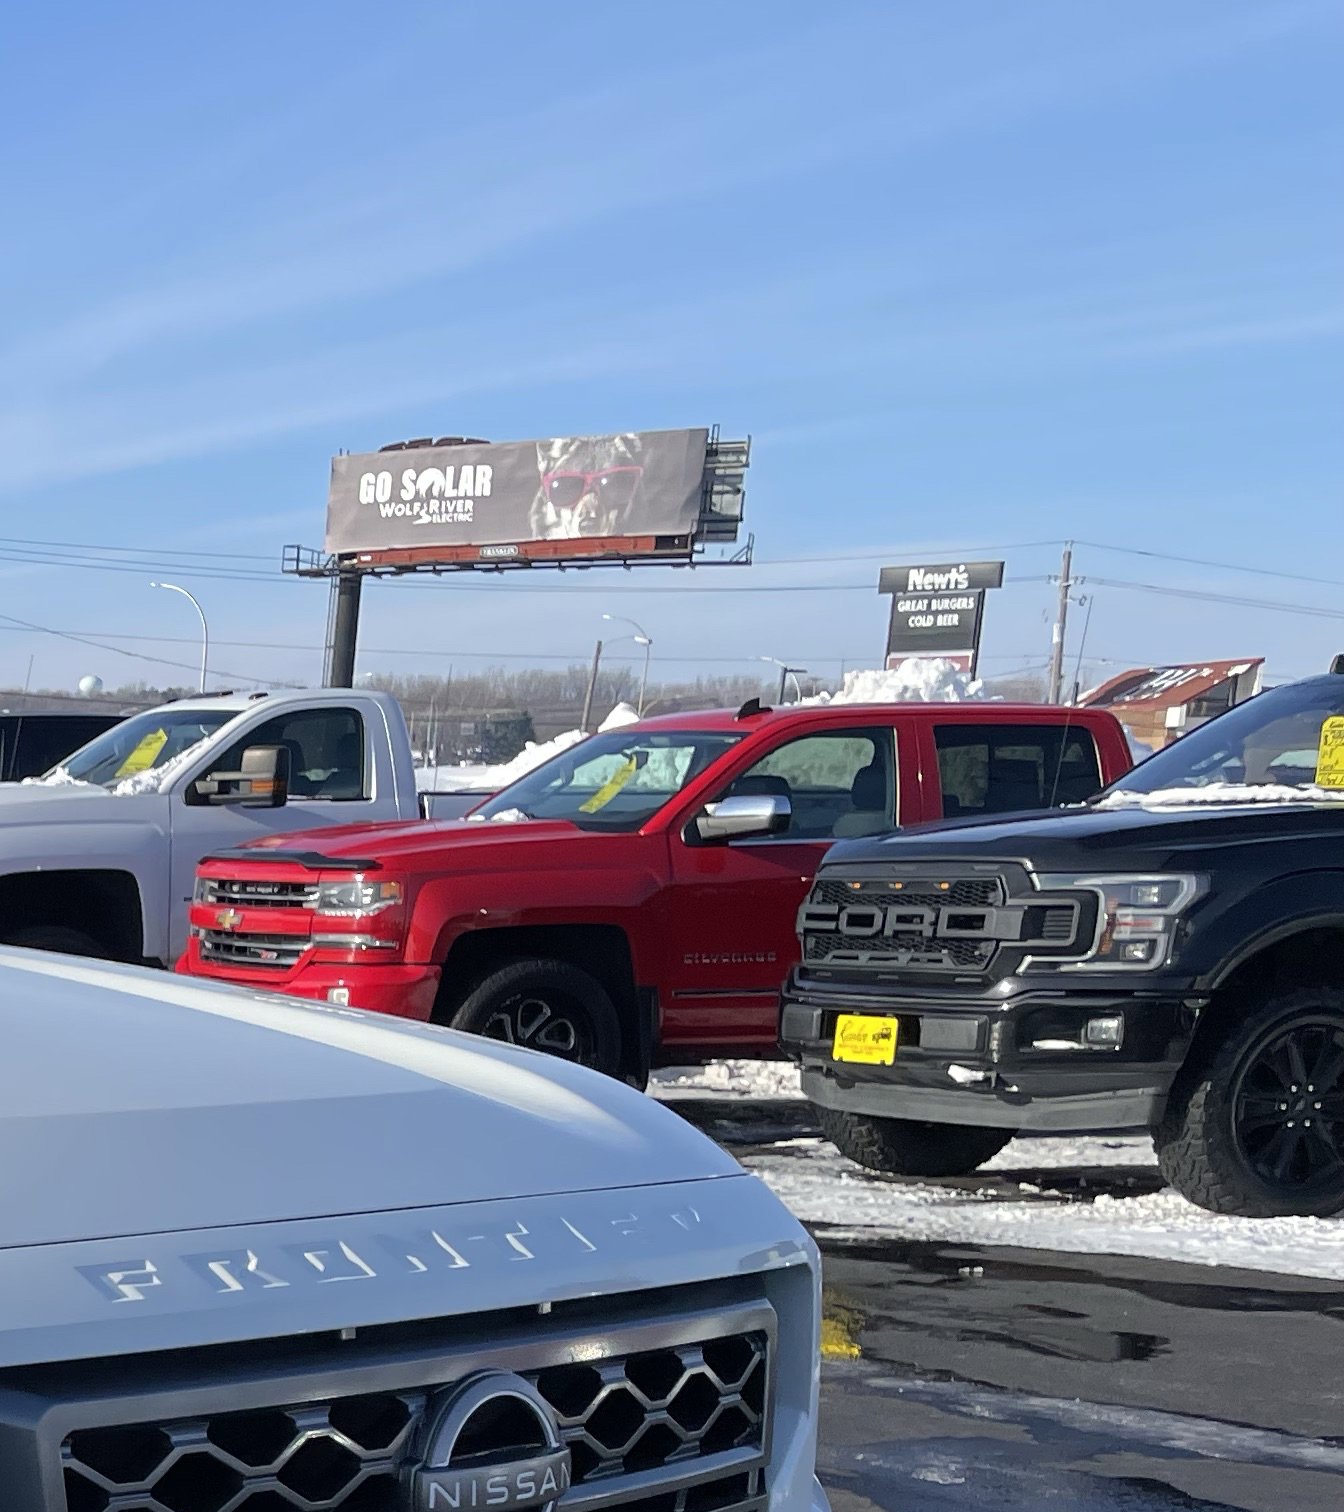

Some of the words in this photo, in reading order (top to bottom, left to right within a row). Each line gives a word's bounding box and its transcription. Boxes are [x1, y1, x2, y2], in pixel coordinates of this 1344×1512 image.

[359, 471, 393, 505] GO
[400, 464, 493, 501] SOLAR
[379, 502, 422, 519] WOLF
[428, 498, 474, 514] RIVER
[908, 564, 969, 591] Newt's
[897, 599, 929, 613] GREAT
[931, 597, 975, 611] BURGERS
[908, 614, 934, 628] COLD
[936, 613, 959, 627] BEER
[796, 903, 995, 939] FORD
[428, 1461, 571, 1509] NISSAN
